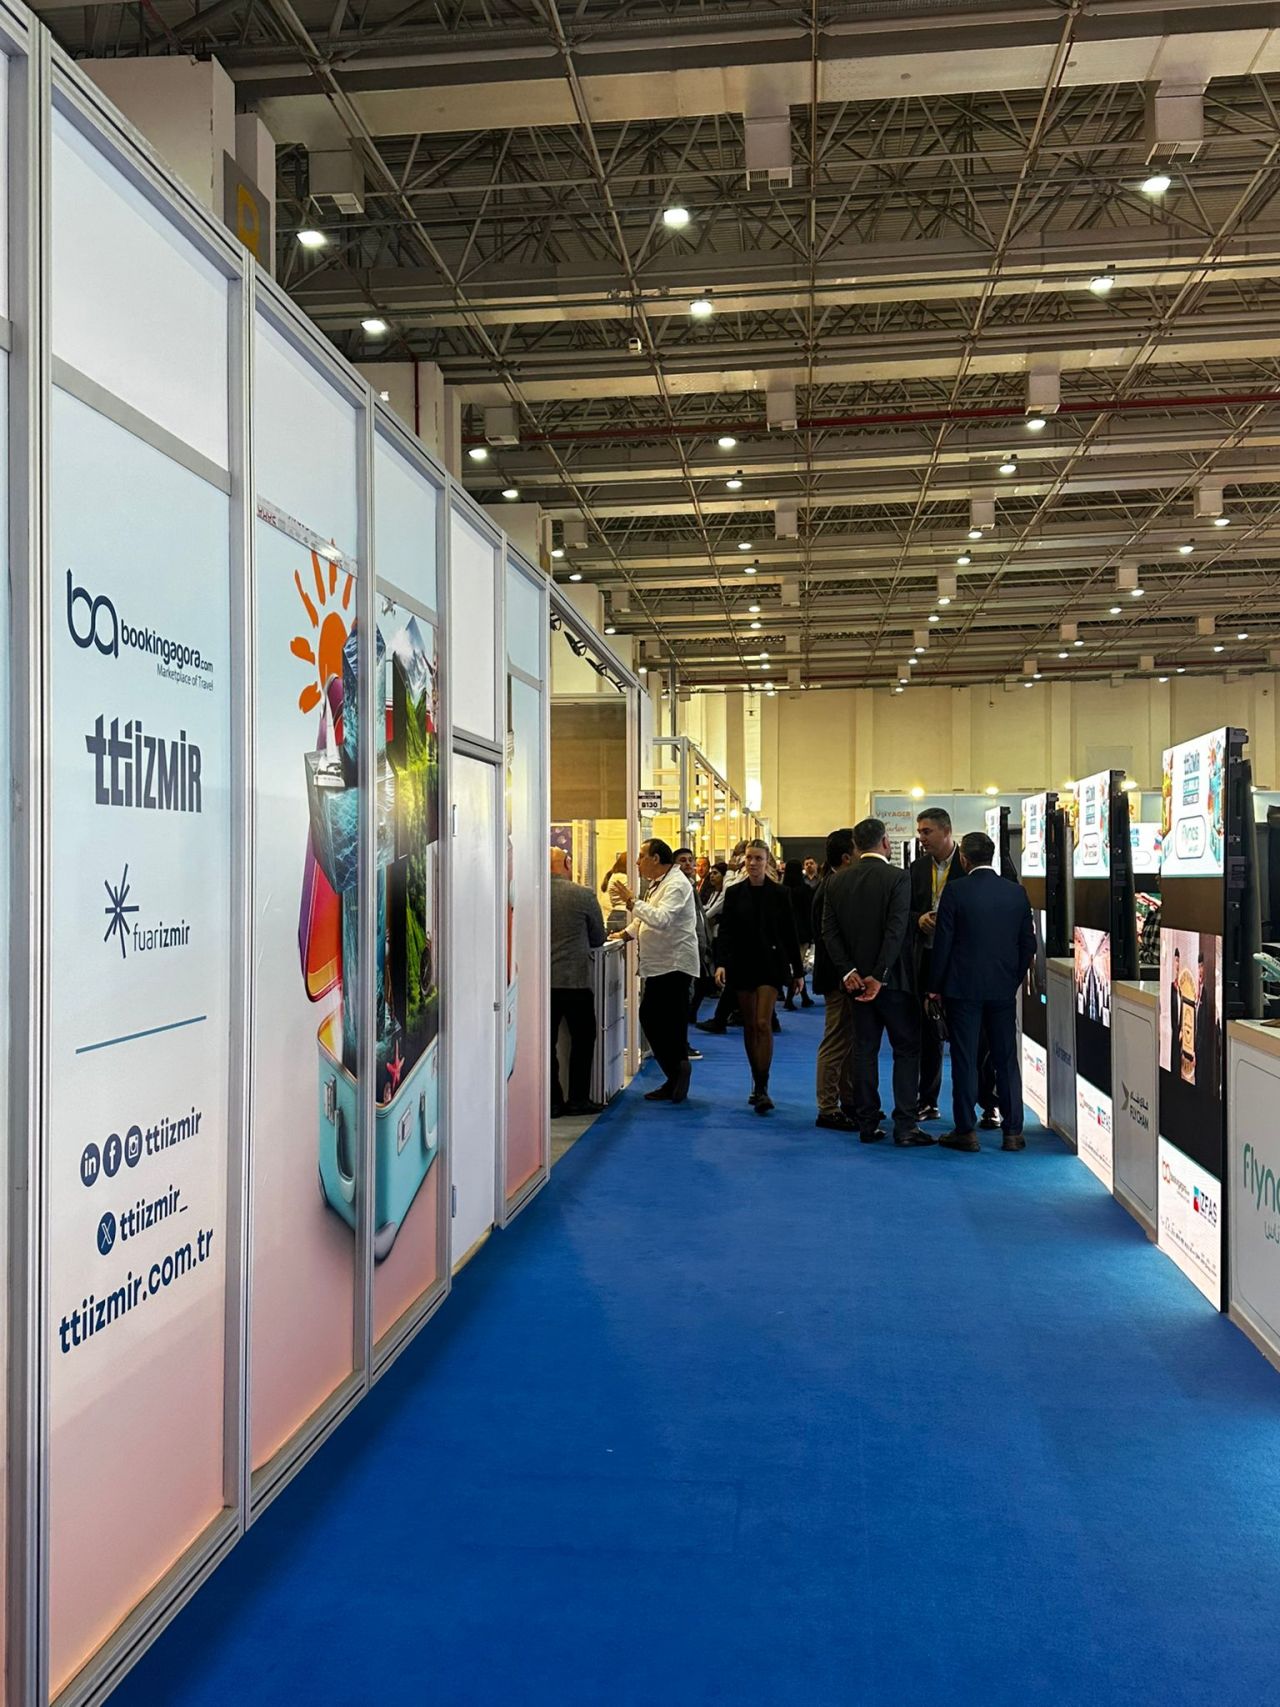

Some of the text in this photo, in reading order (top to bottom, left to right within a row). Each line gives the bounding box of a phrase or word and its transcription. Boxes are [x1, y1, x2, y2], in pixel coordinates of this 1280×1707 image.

[133, 919, 190, 951] fuarizmir
[145, 1106, 202, 1156] ttiizmir
[59, 1227, 213, 1354] ttiizmir.com.tr
